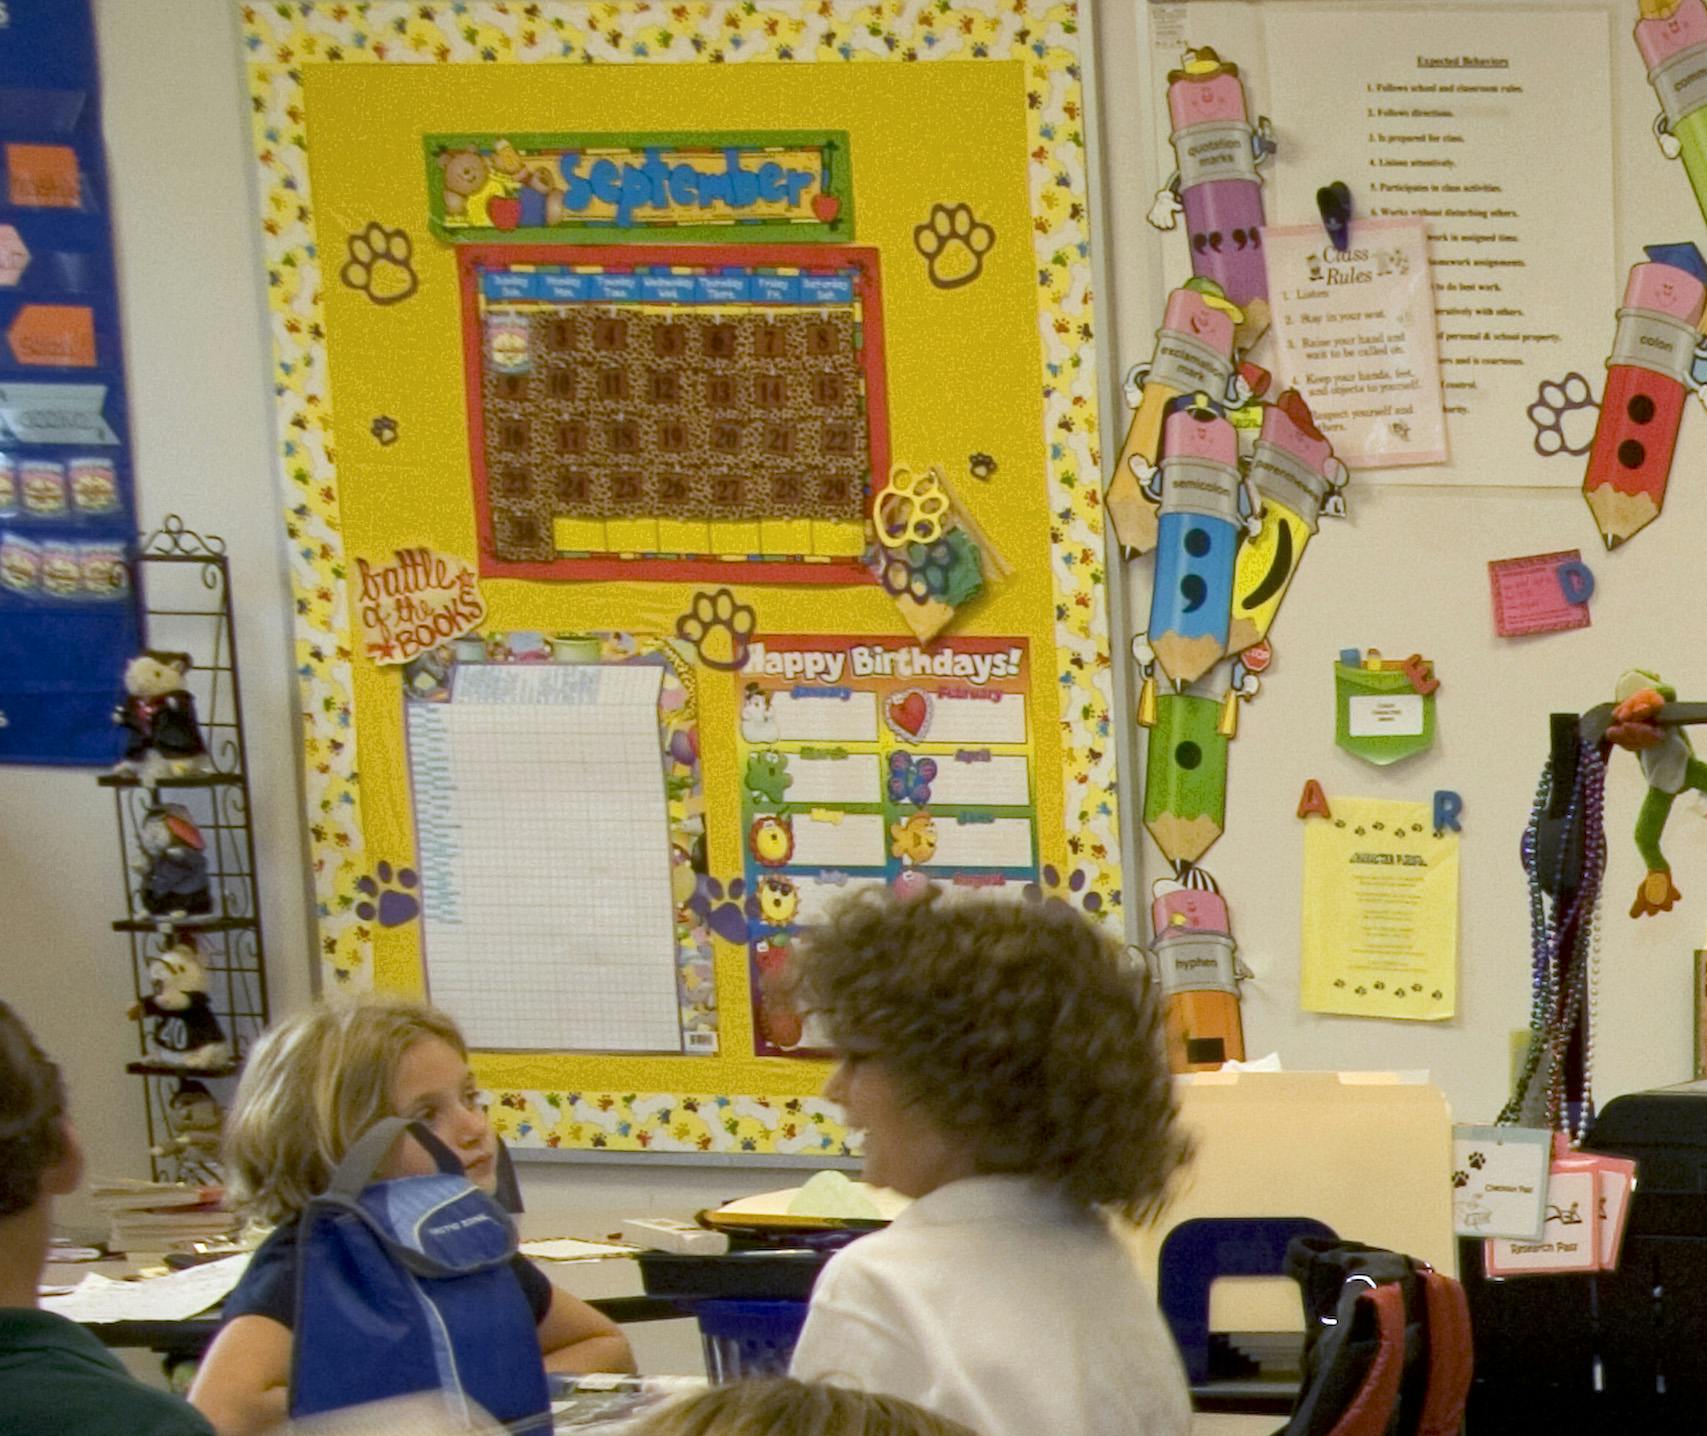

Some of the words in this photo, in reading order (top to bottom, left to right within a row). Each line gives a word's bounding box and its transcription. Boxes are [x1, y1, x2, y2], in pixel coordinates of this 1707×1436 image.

[1417, 56, 1460, 67] Expected
[1463, 56, 1510, 67] Behaviors
[1187, 138, 1241, 157] quotation
[1199, 153, 1235, 166] marks
[560, 145, 815, 227] September
[1323, 247, 1369, 264] Class
[1326, 267, 1373, 286] Rules
[1639, 334, 1674, 353] colon
[1172, 479, 1231, 496] semicolon
[356, 548, 456, 602] battle
[1556, 562, 1595, 605] D
[363, 604, 391, 643] of
[396, 594, 434, 626] the
[396, 590, 485, 660] BOOKS
[743, 642, 846, 684] Happy
[850, 646, 1024, 686] Birthdays!
[1405, 654, 1440, 695] E
[1297, 779, 1331, 819] A
[1433, 791, 1463, 832] R
[1175, 958, 1218, 972] hyphen
[1511, 1244, 1554, 1254] Research
[1557, 1242, 1578, 1254] Pass
